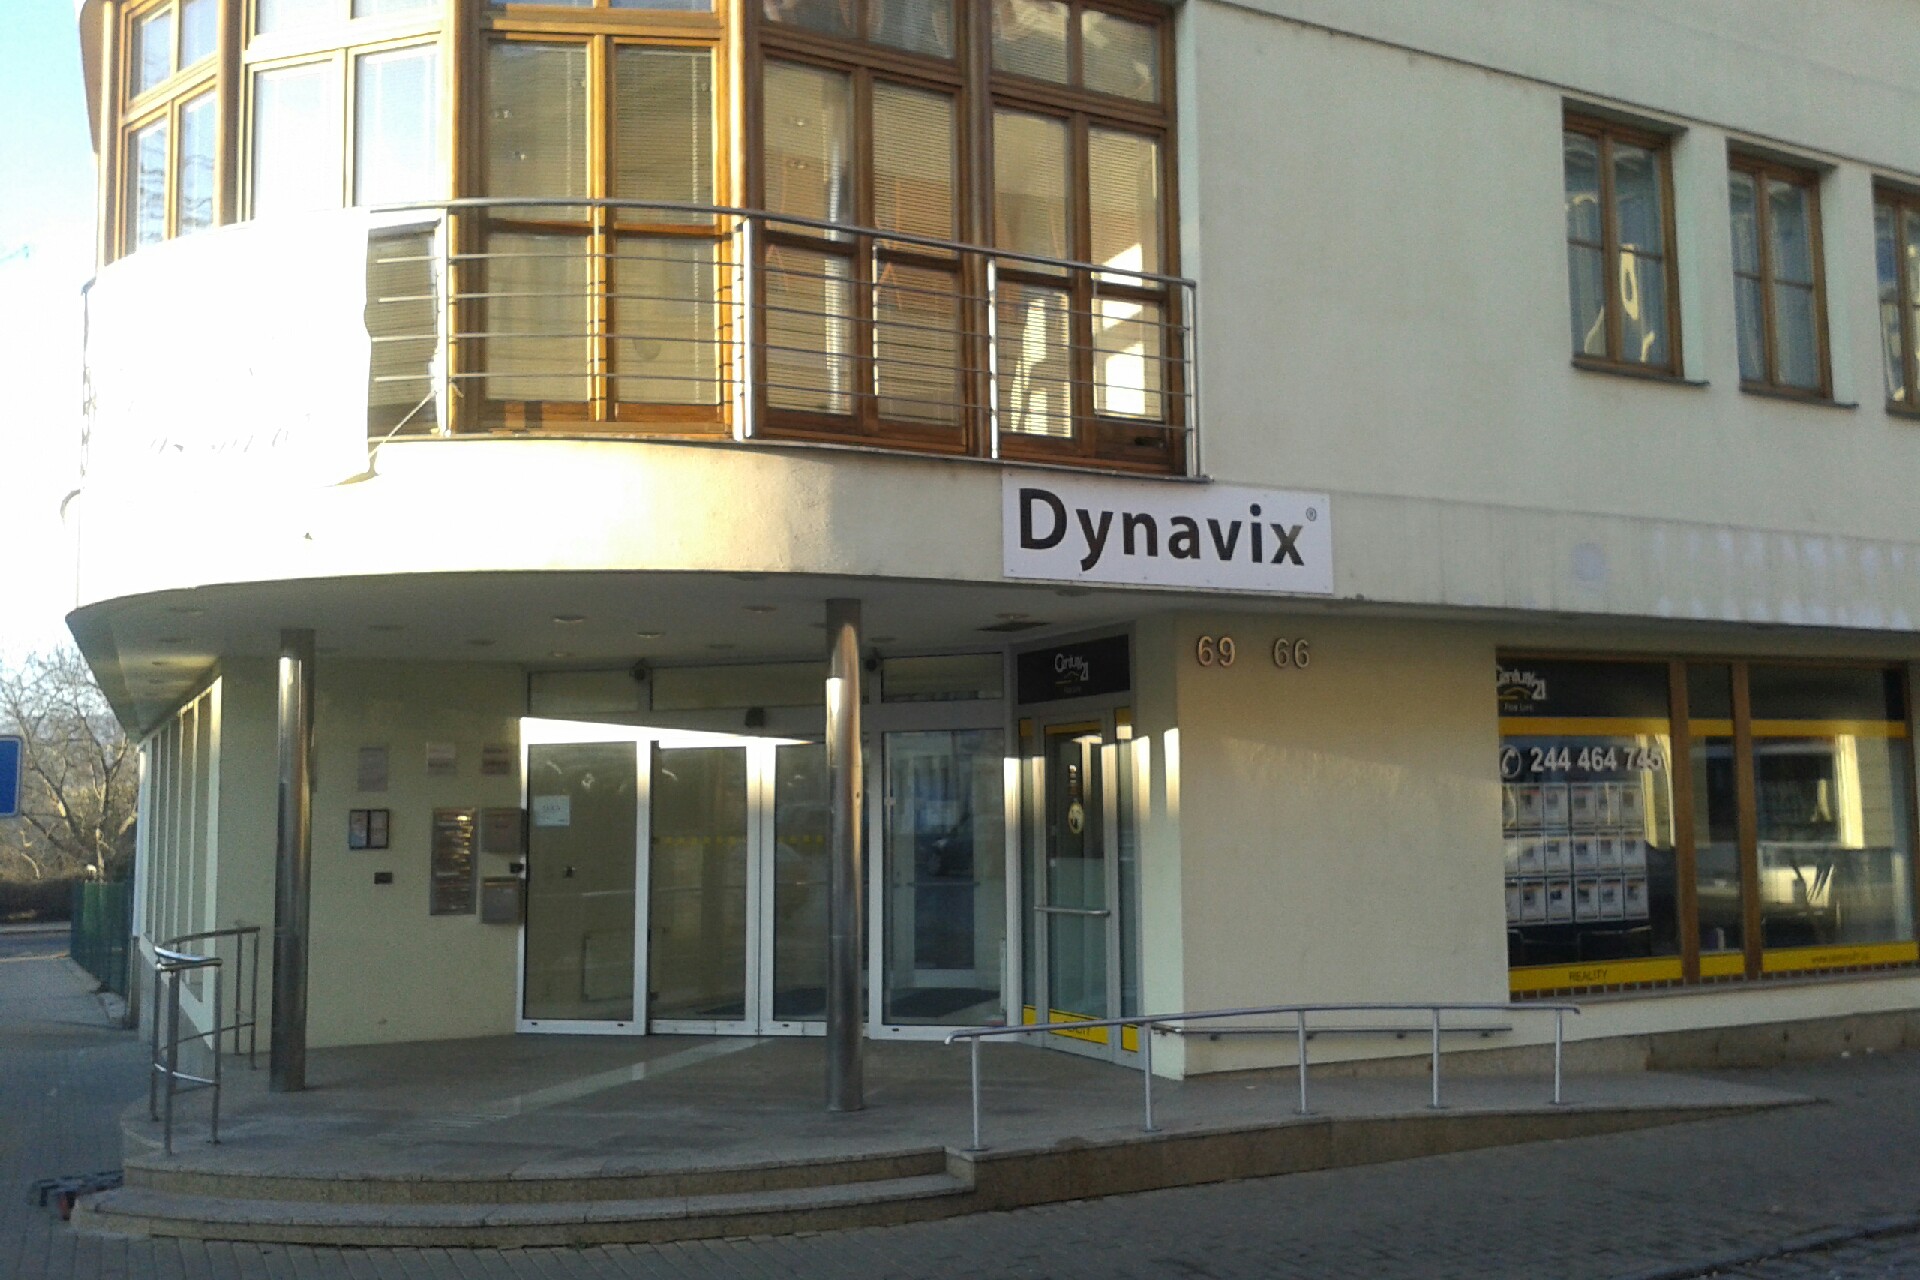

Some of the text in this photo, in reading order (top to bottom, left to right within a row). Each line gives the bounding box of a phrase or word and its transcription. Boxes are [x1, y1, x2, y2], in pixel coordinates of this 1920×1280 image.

[1198, 635, 1310, 668] 69 66
[1530, 746, 1571, 772] 244
[1576, 746, 1617, 772] 464
